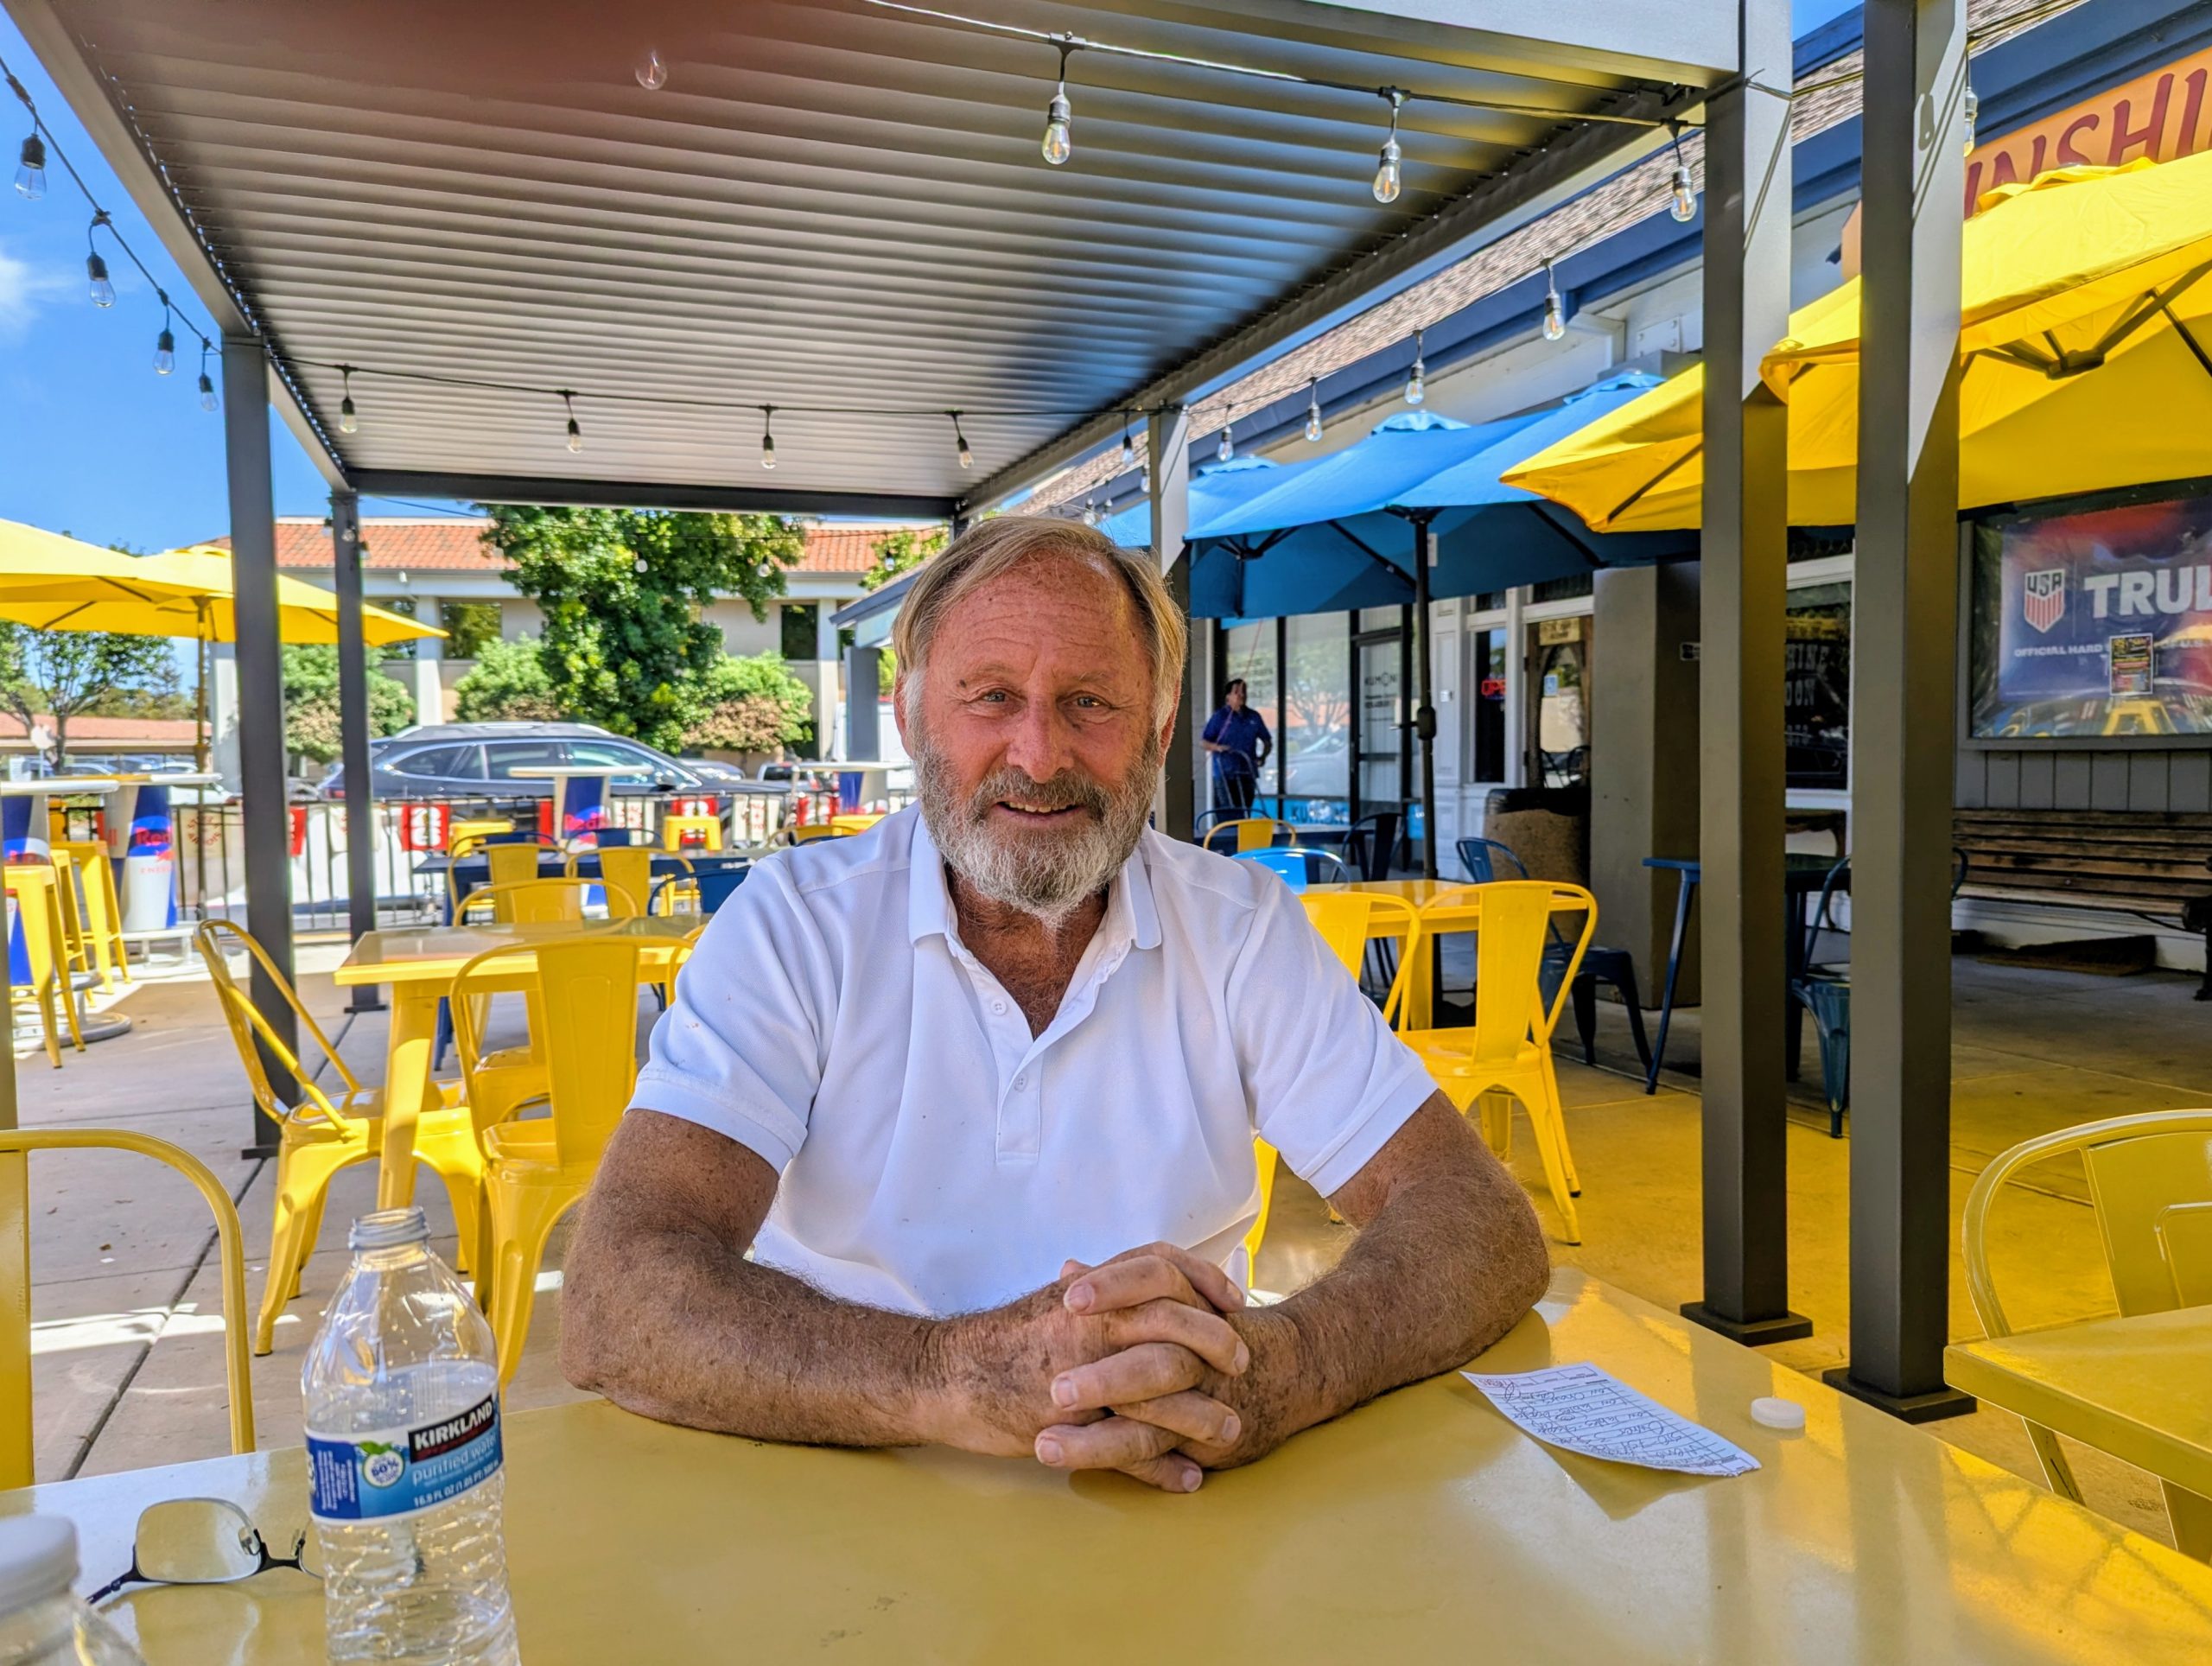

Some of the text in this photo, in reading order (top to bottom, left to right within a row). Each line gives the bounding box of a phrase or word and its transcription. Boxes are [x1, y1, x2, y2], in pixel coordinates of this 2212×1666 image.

[2027, 572, 2062, 596] USA
[2014, 645, 2066, 657] OFFICIAL
[2068, 645, 2102, 655] HARD
[414, 1401, 493, 1451] KIRKLAND
[413, 1449, 468, 1485] purified
[471, 1432, 497, 1459] water
